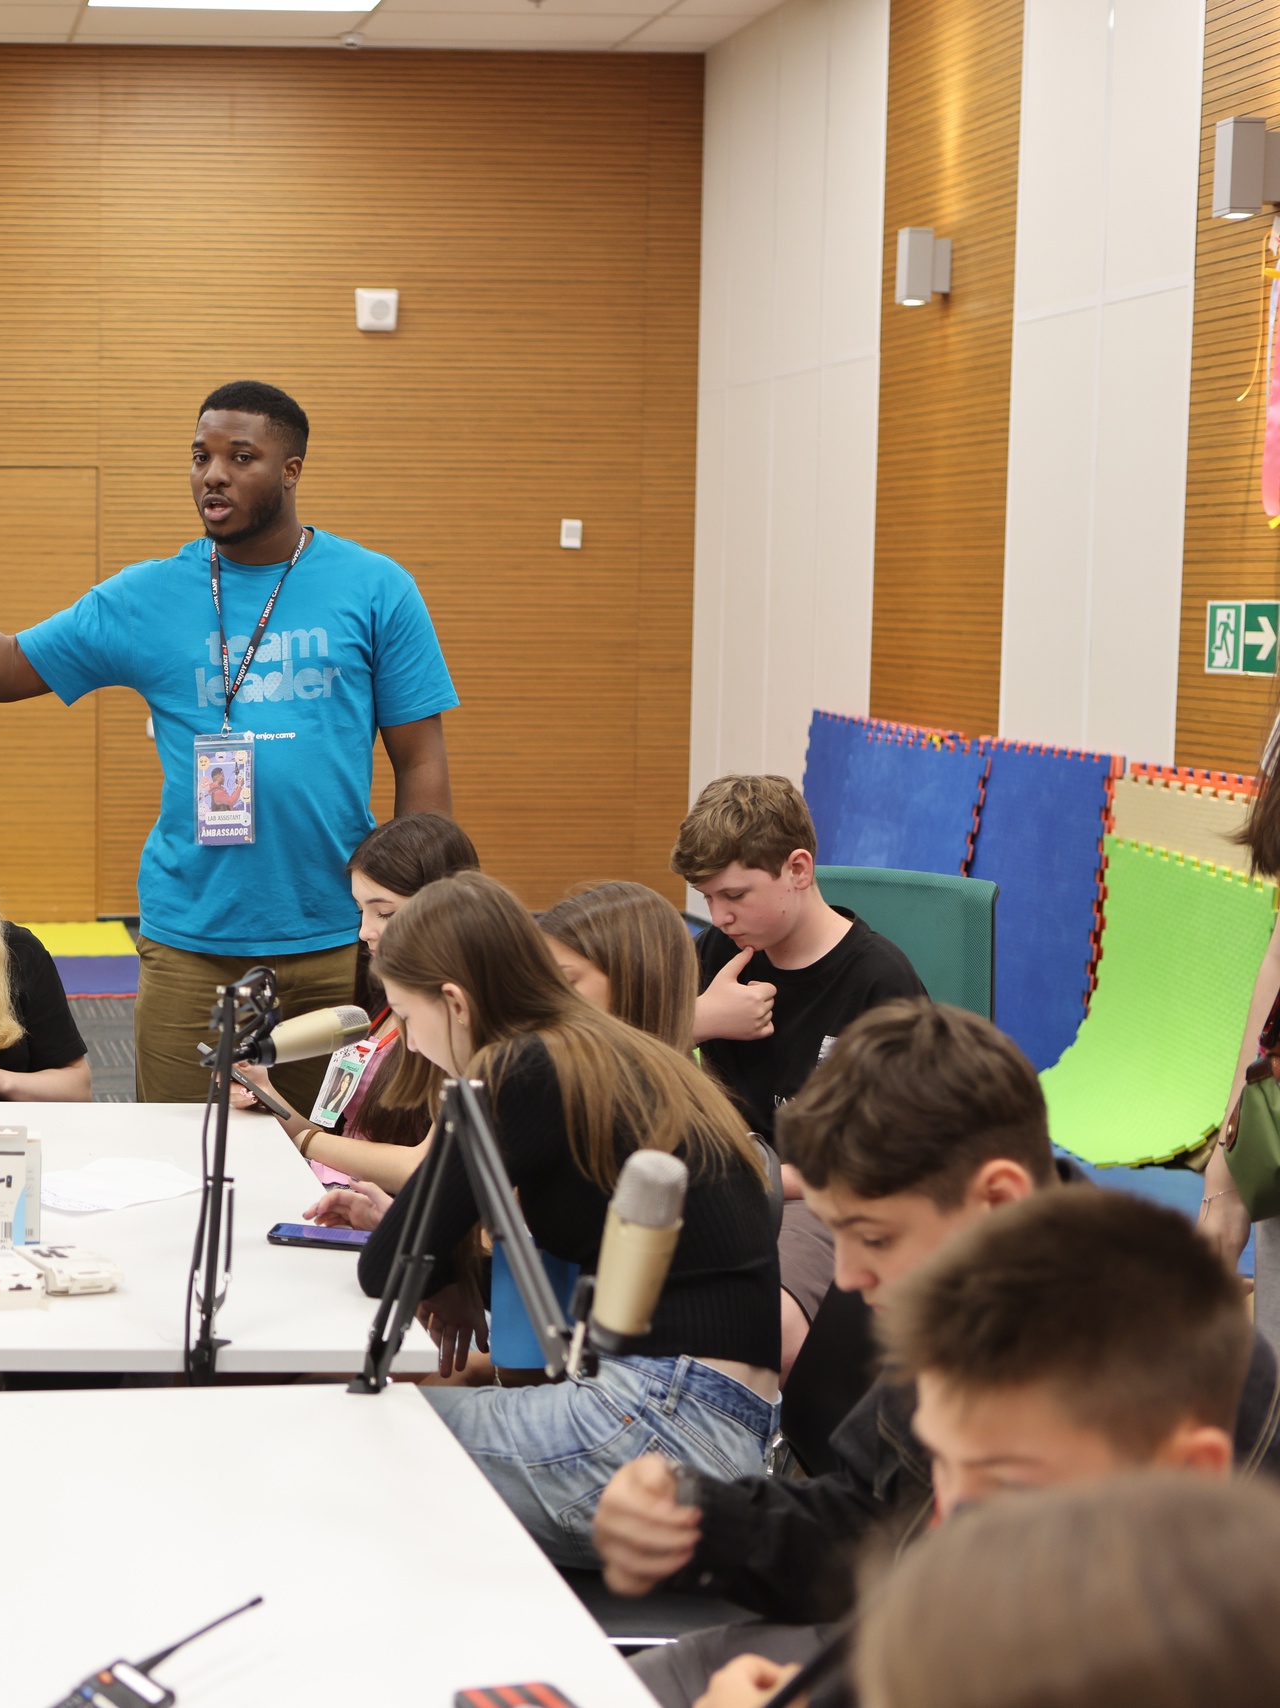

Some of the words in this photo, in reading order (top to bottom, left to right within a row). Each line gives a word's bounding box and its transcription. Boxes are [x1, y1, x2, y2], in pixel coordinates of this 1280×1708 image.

[262, 597, 275, 618] ENJOY
[205, 627, 329, 666] team
[235, 664, 247, 686] ENJOY
[243, 645, 255, 665] CAMP
[195, 659, 341, 707] leader
[255, 732, 275, 740] enjoy
[276, 731, 296, 739] camp
[201, 828, 248, 837] AMBASSADOR
